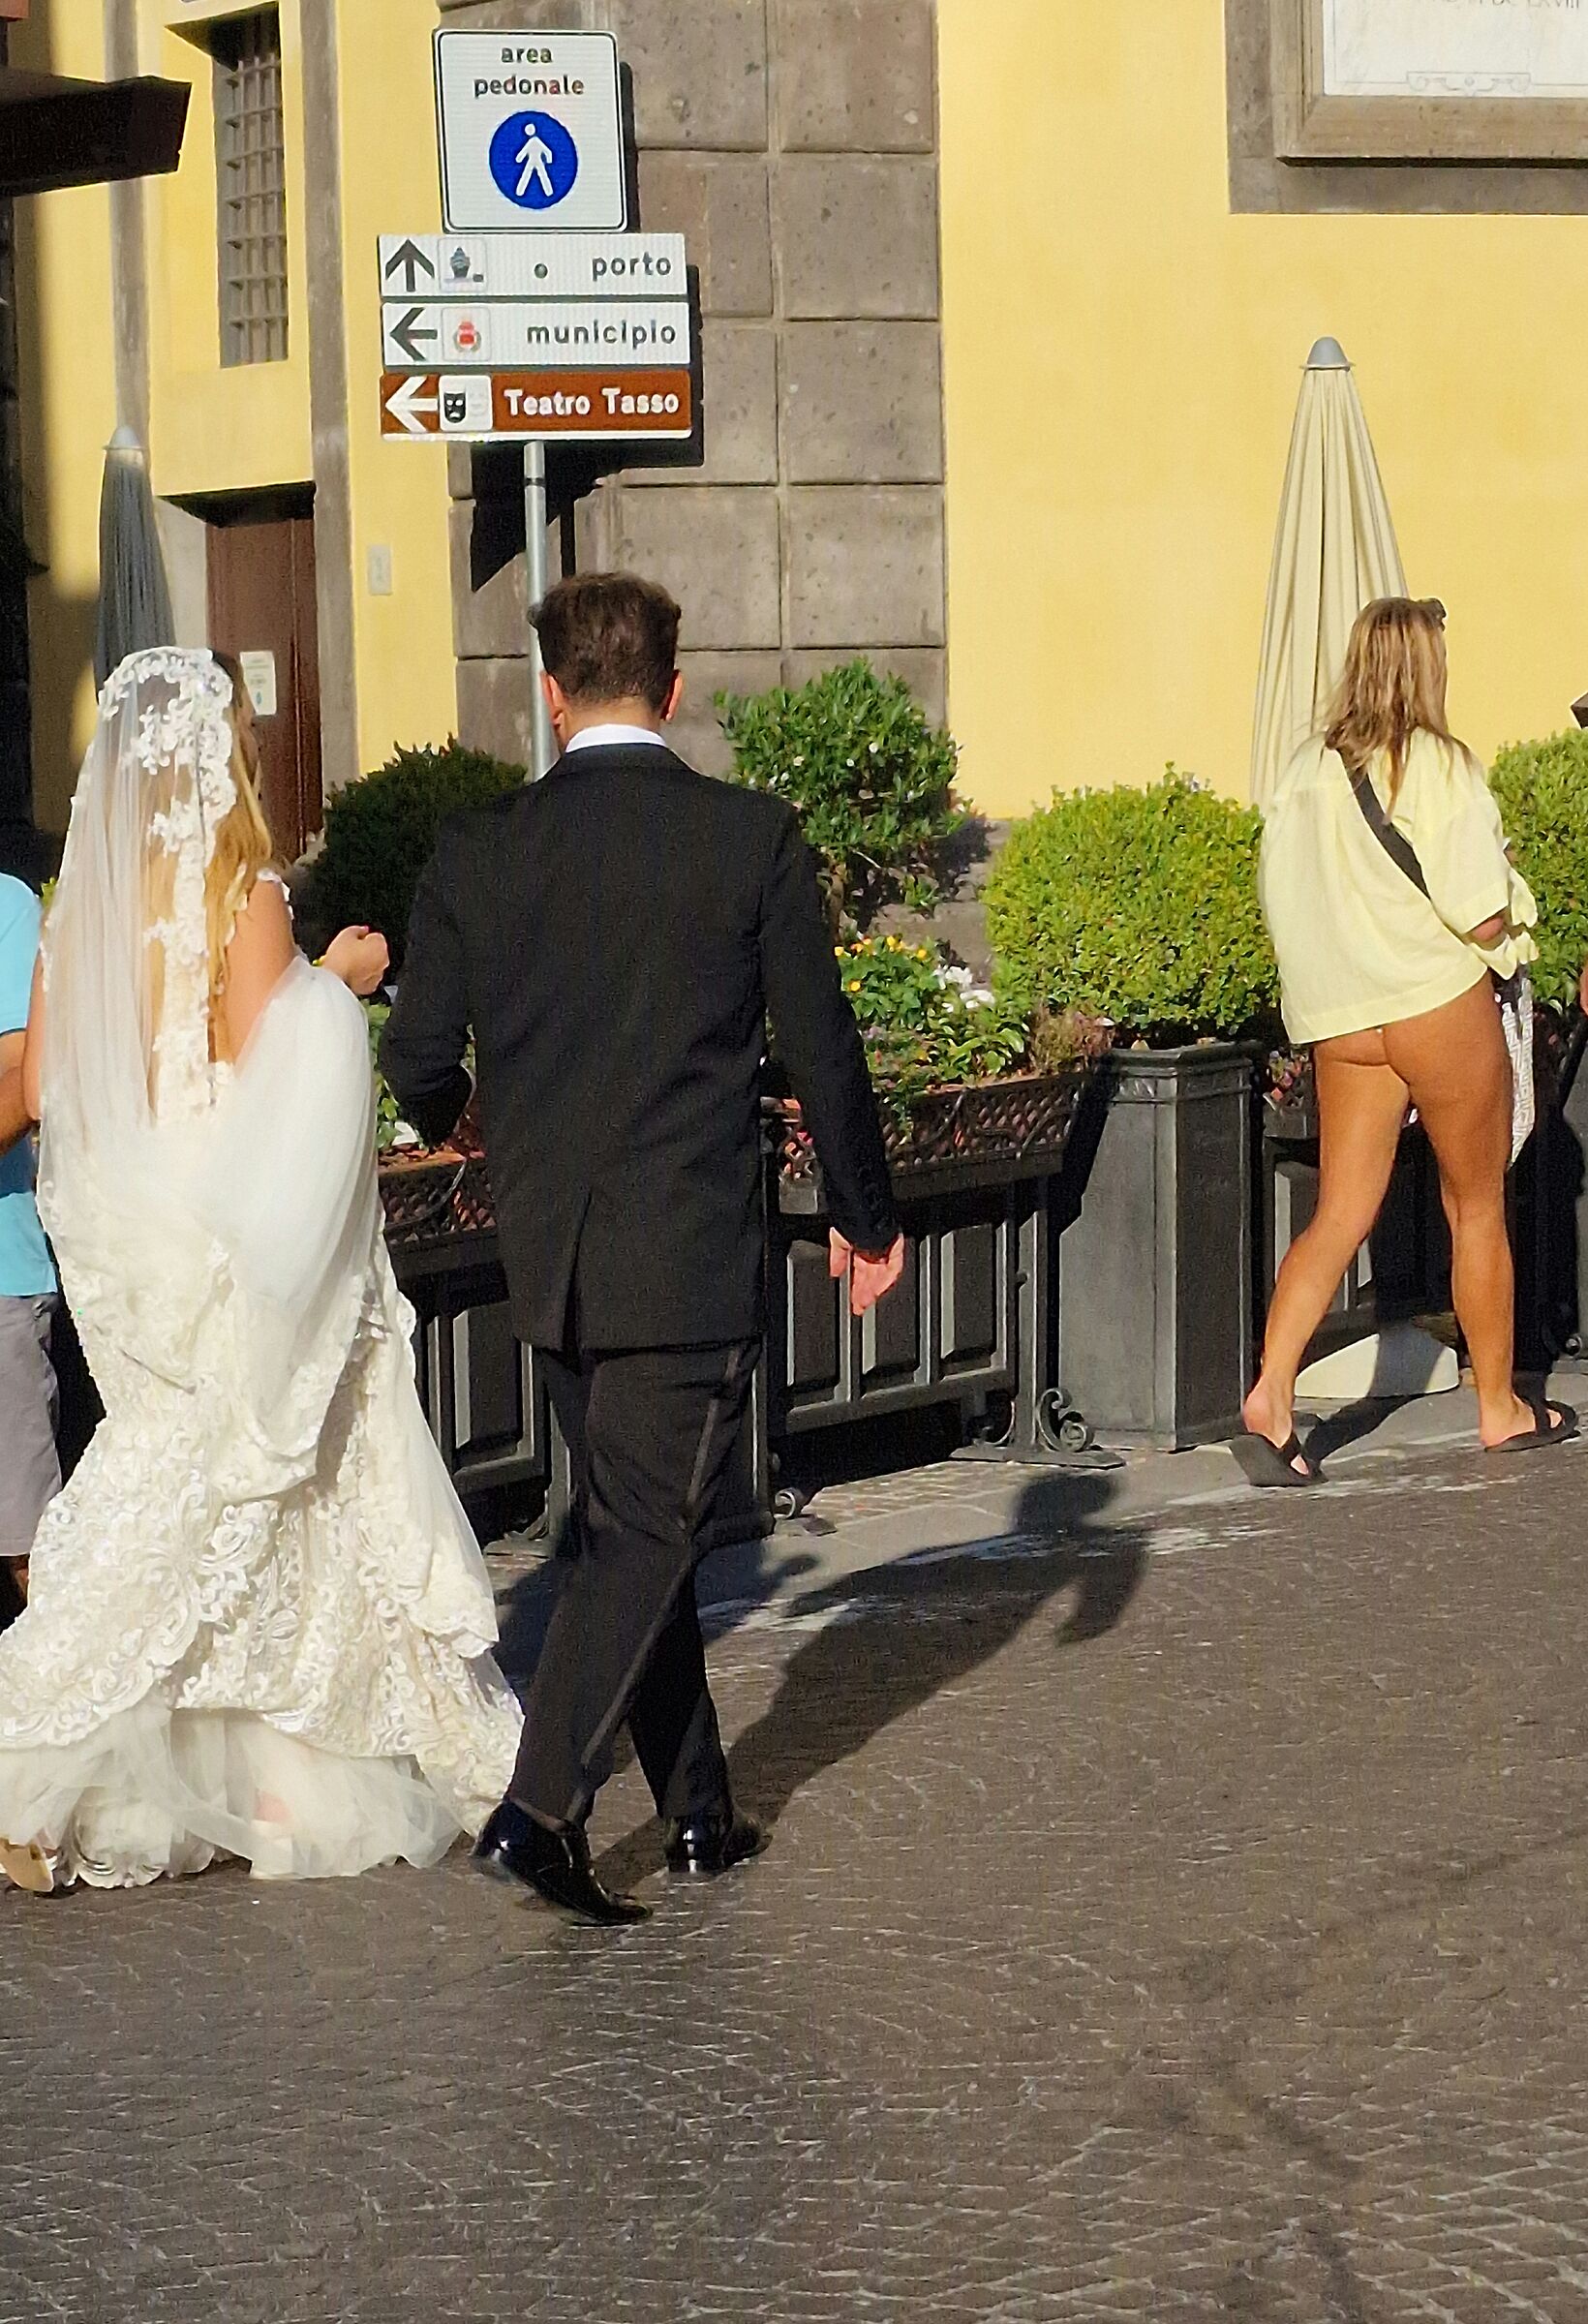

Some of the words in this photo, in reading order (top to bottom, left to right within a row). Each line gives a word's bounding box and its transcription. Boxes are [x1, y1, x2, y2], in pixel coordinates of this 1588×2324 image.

[501, 46, 553, 64] area
[474, 75, 585, 98] pedonale
[591, 252, 672, 281] porto
[527, 320, 677, 351] municipio
[504, 389, 591, 417] Teatro
[602, 387, 680, 415] Tasso
